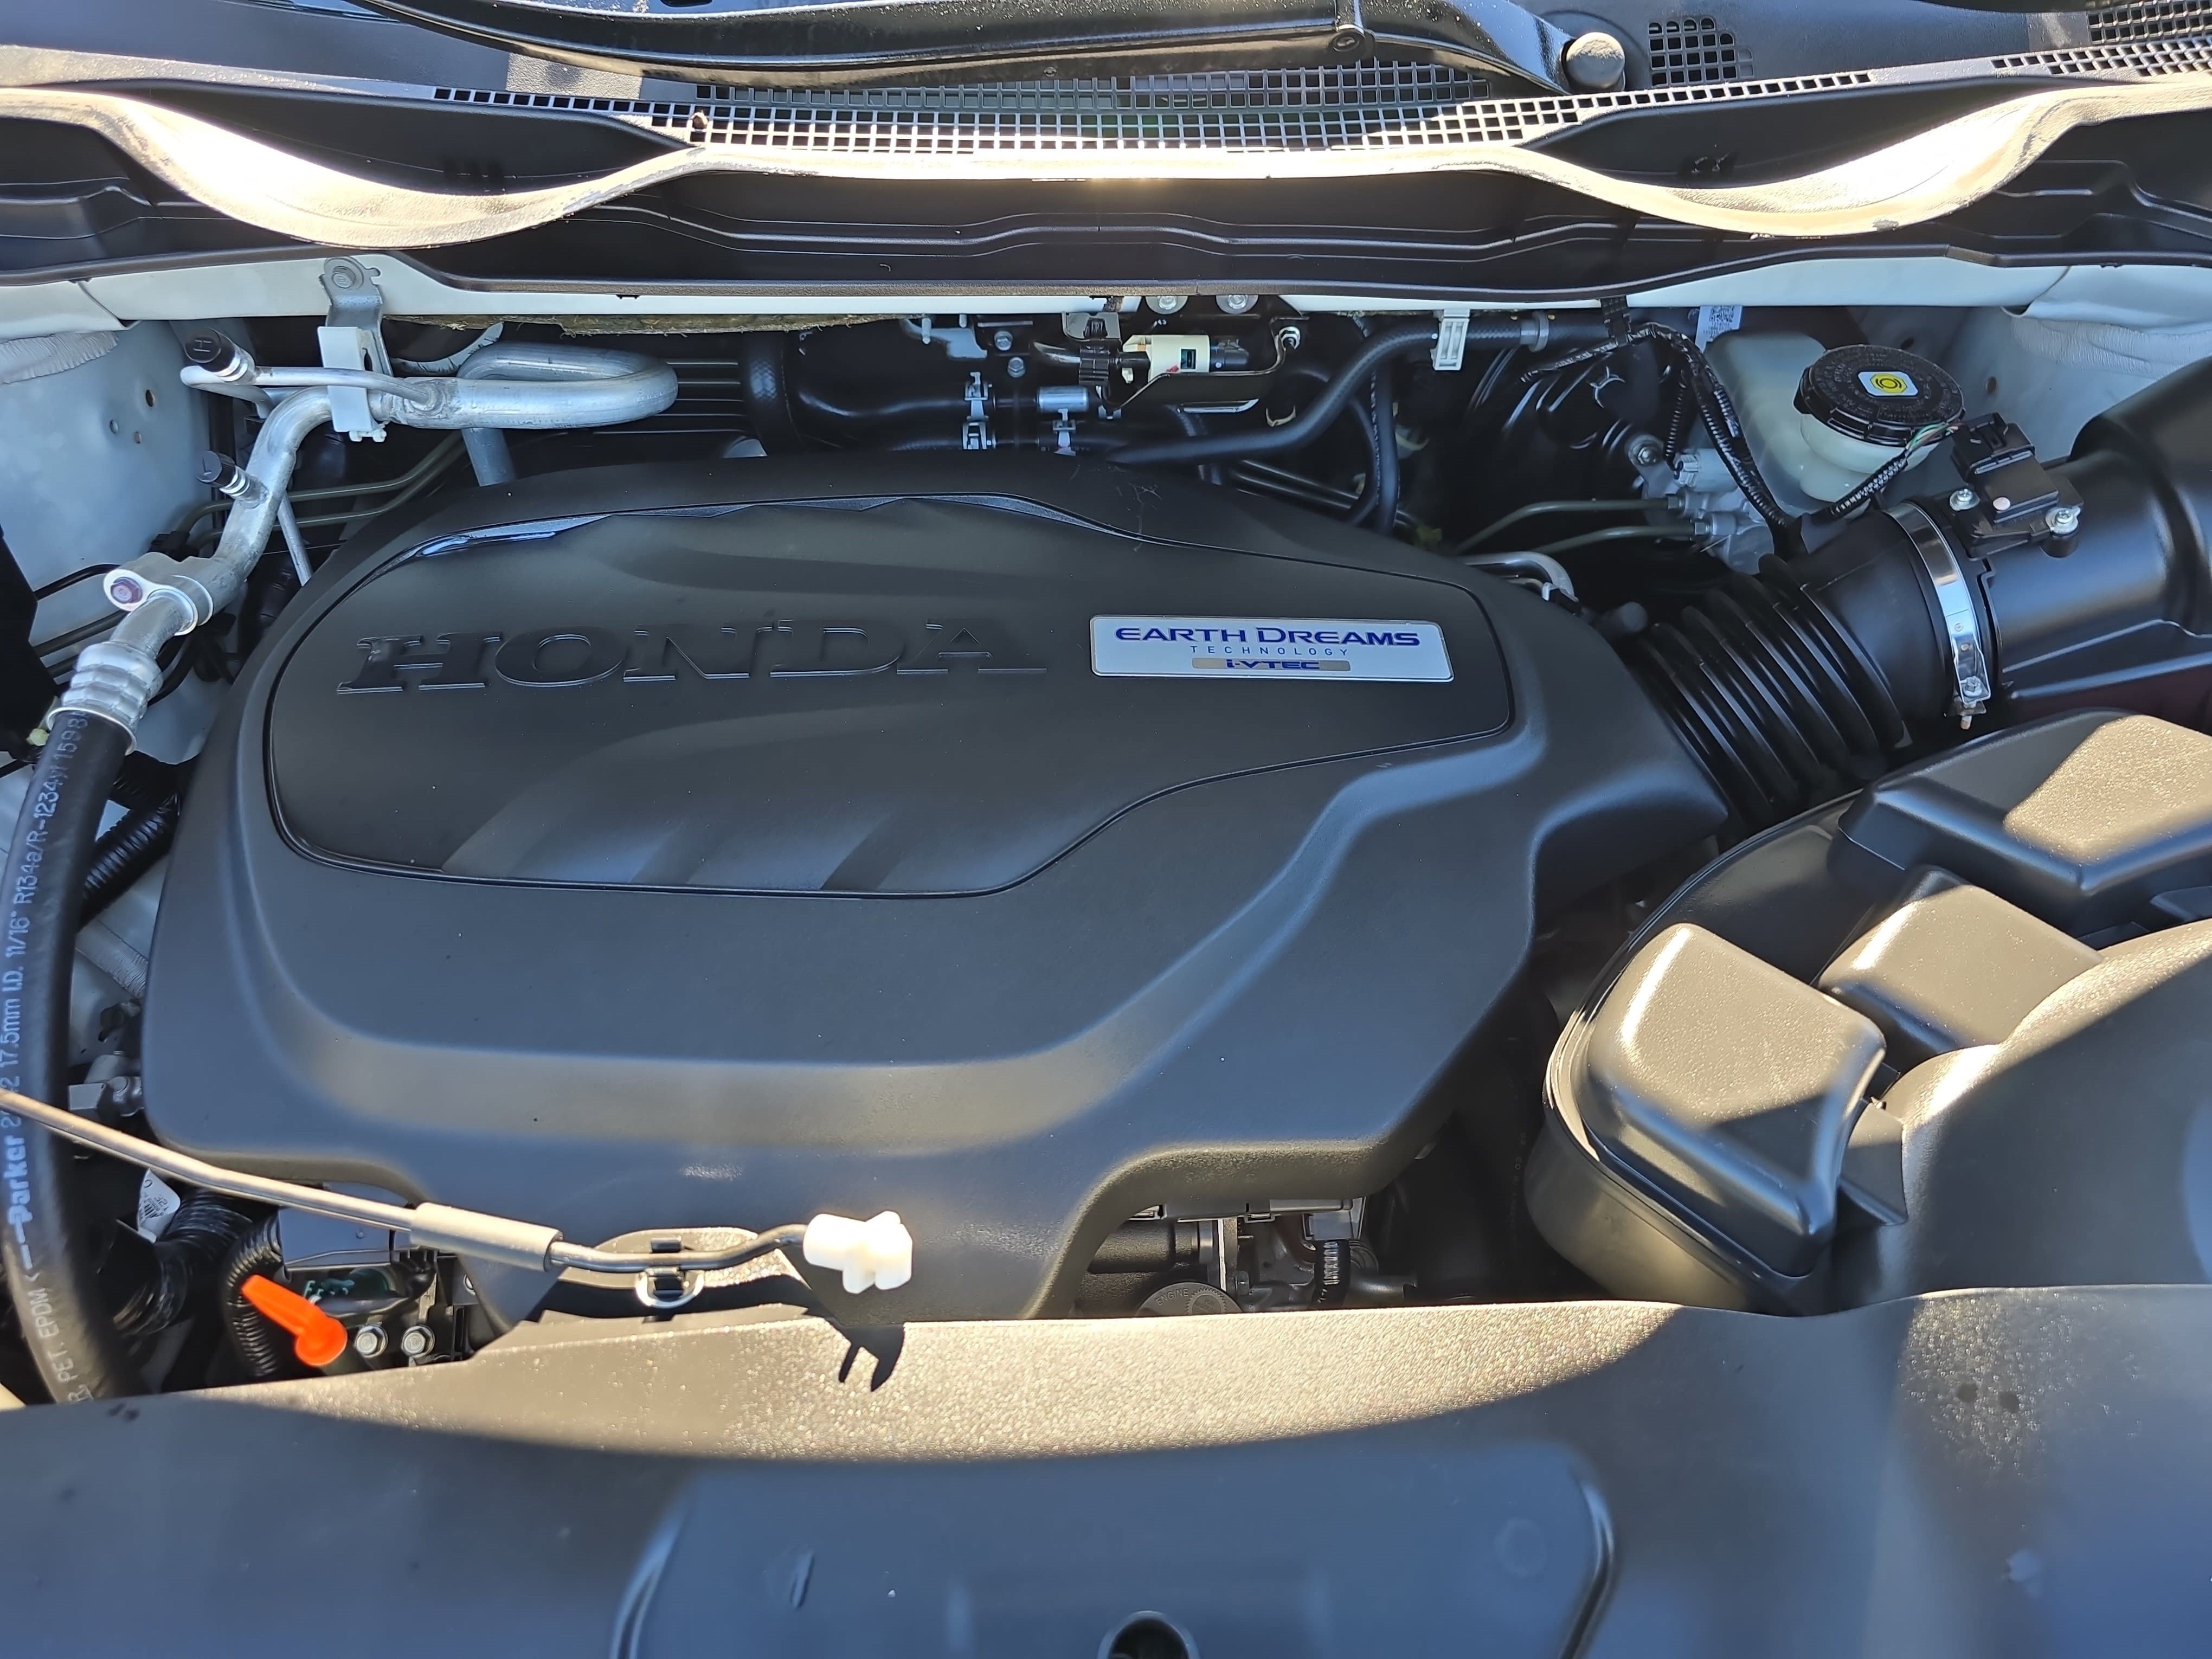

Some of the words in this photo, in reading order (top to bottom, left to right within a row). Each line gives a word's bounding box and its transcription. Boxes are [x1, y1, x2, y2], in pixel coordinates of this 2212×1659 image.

[1115, 627, 1246, 644] EARTH
[1256, 627, 1420, 647] DREAMS
[1190, 645, 1349, 657] TECHNOLOGY
[336, 618, 1047, 695] HONDA
[1225, 659, 1320, 670] i-VTEC
[14, 764, 68, 905] R134a/R-1234yf
[2, 966, 24, 992] I.D.
[0, 999, 21, 1068] 17.5mm
[4, 1135, 33, 1224] Parker
[29, 1288, 59, 1338] EPDM
[1154, 1287, 1189, 1306] ENGINE
